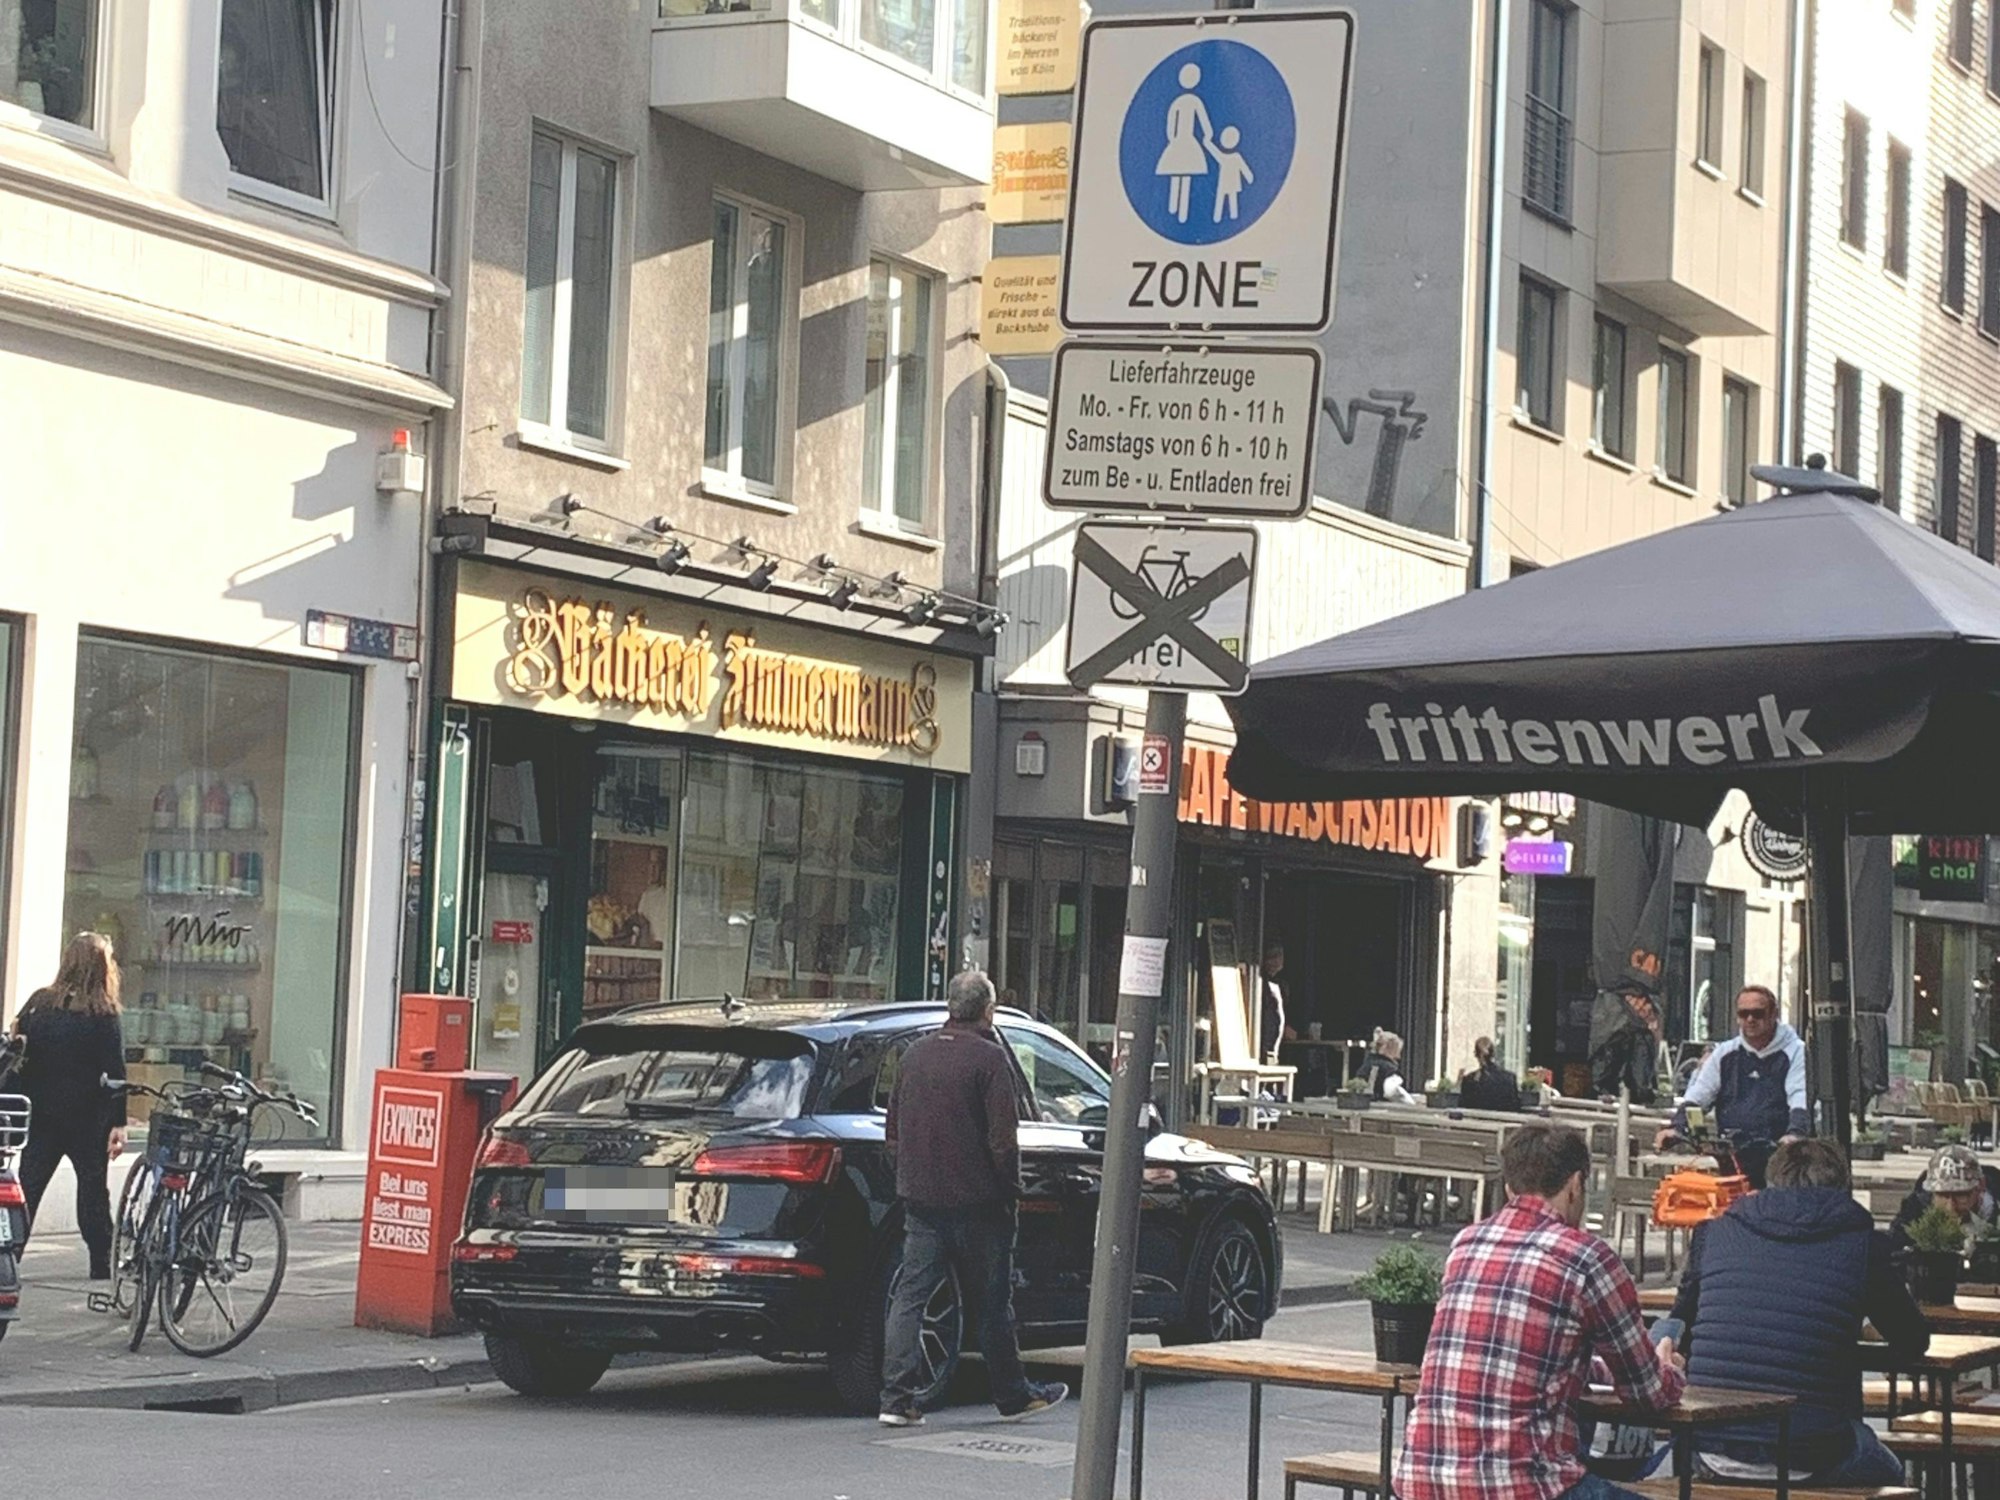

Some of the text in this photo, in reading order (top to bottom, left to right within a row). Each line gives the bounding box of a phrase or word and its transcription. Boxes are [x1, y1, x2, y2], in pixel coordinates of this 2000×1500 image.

[993, 274, 1057, 288] Qualität und
[1128, 261, 1262, 308] ZONE
[1000, 291, 1039, 303] Frische
[988, 306, 1057, 319] direkt aus de
[996, 321, 1050, 334] Backstube
[1109, 359, 1256, 392] Lieferfahrzeuge
[1129, 396, 1151, 419] Fr.
[1158, 401, 1192, 420] von
[1247, 399, 1266, 423] 11
[1065, 428, 1155, 460] Samstags
[1161, 436, 1195, 456] von
[1249, 436, 1271, 460] 10
[1062, 467, 1100, 488] zum
[1170, 468, 1253, 495] Entladen
[1259, 471, 1291, 497] frei
[557, 600, 713, 714] Bäckerei
[723, 633, 912, 746] Zimmermann
[443, 721, 469, 755] 75
[1366, 694, 1823, 766] frittenwerk
[1929, 862, 1976, 880] chai
[381, 1102, 436, 1150] EXPRESS
[379, 1171, 429, 1197] Bei uns
[372, 1196, 432, 1224] liest man
[369, 1221, 430, 1250] EXPRESS
